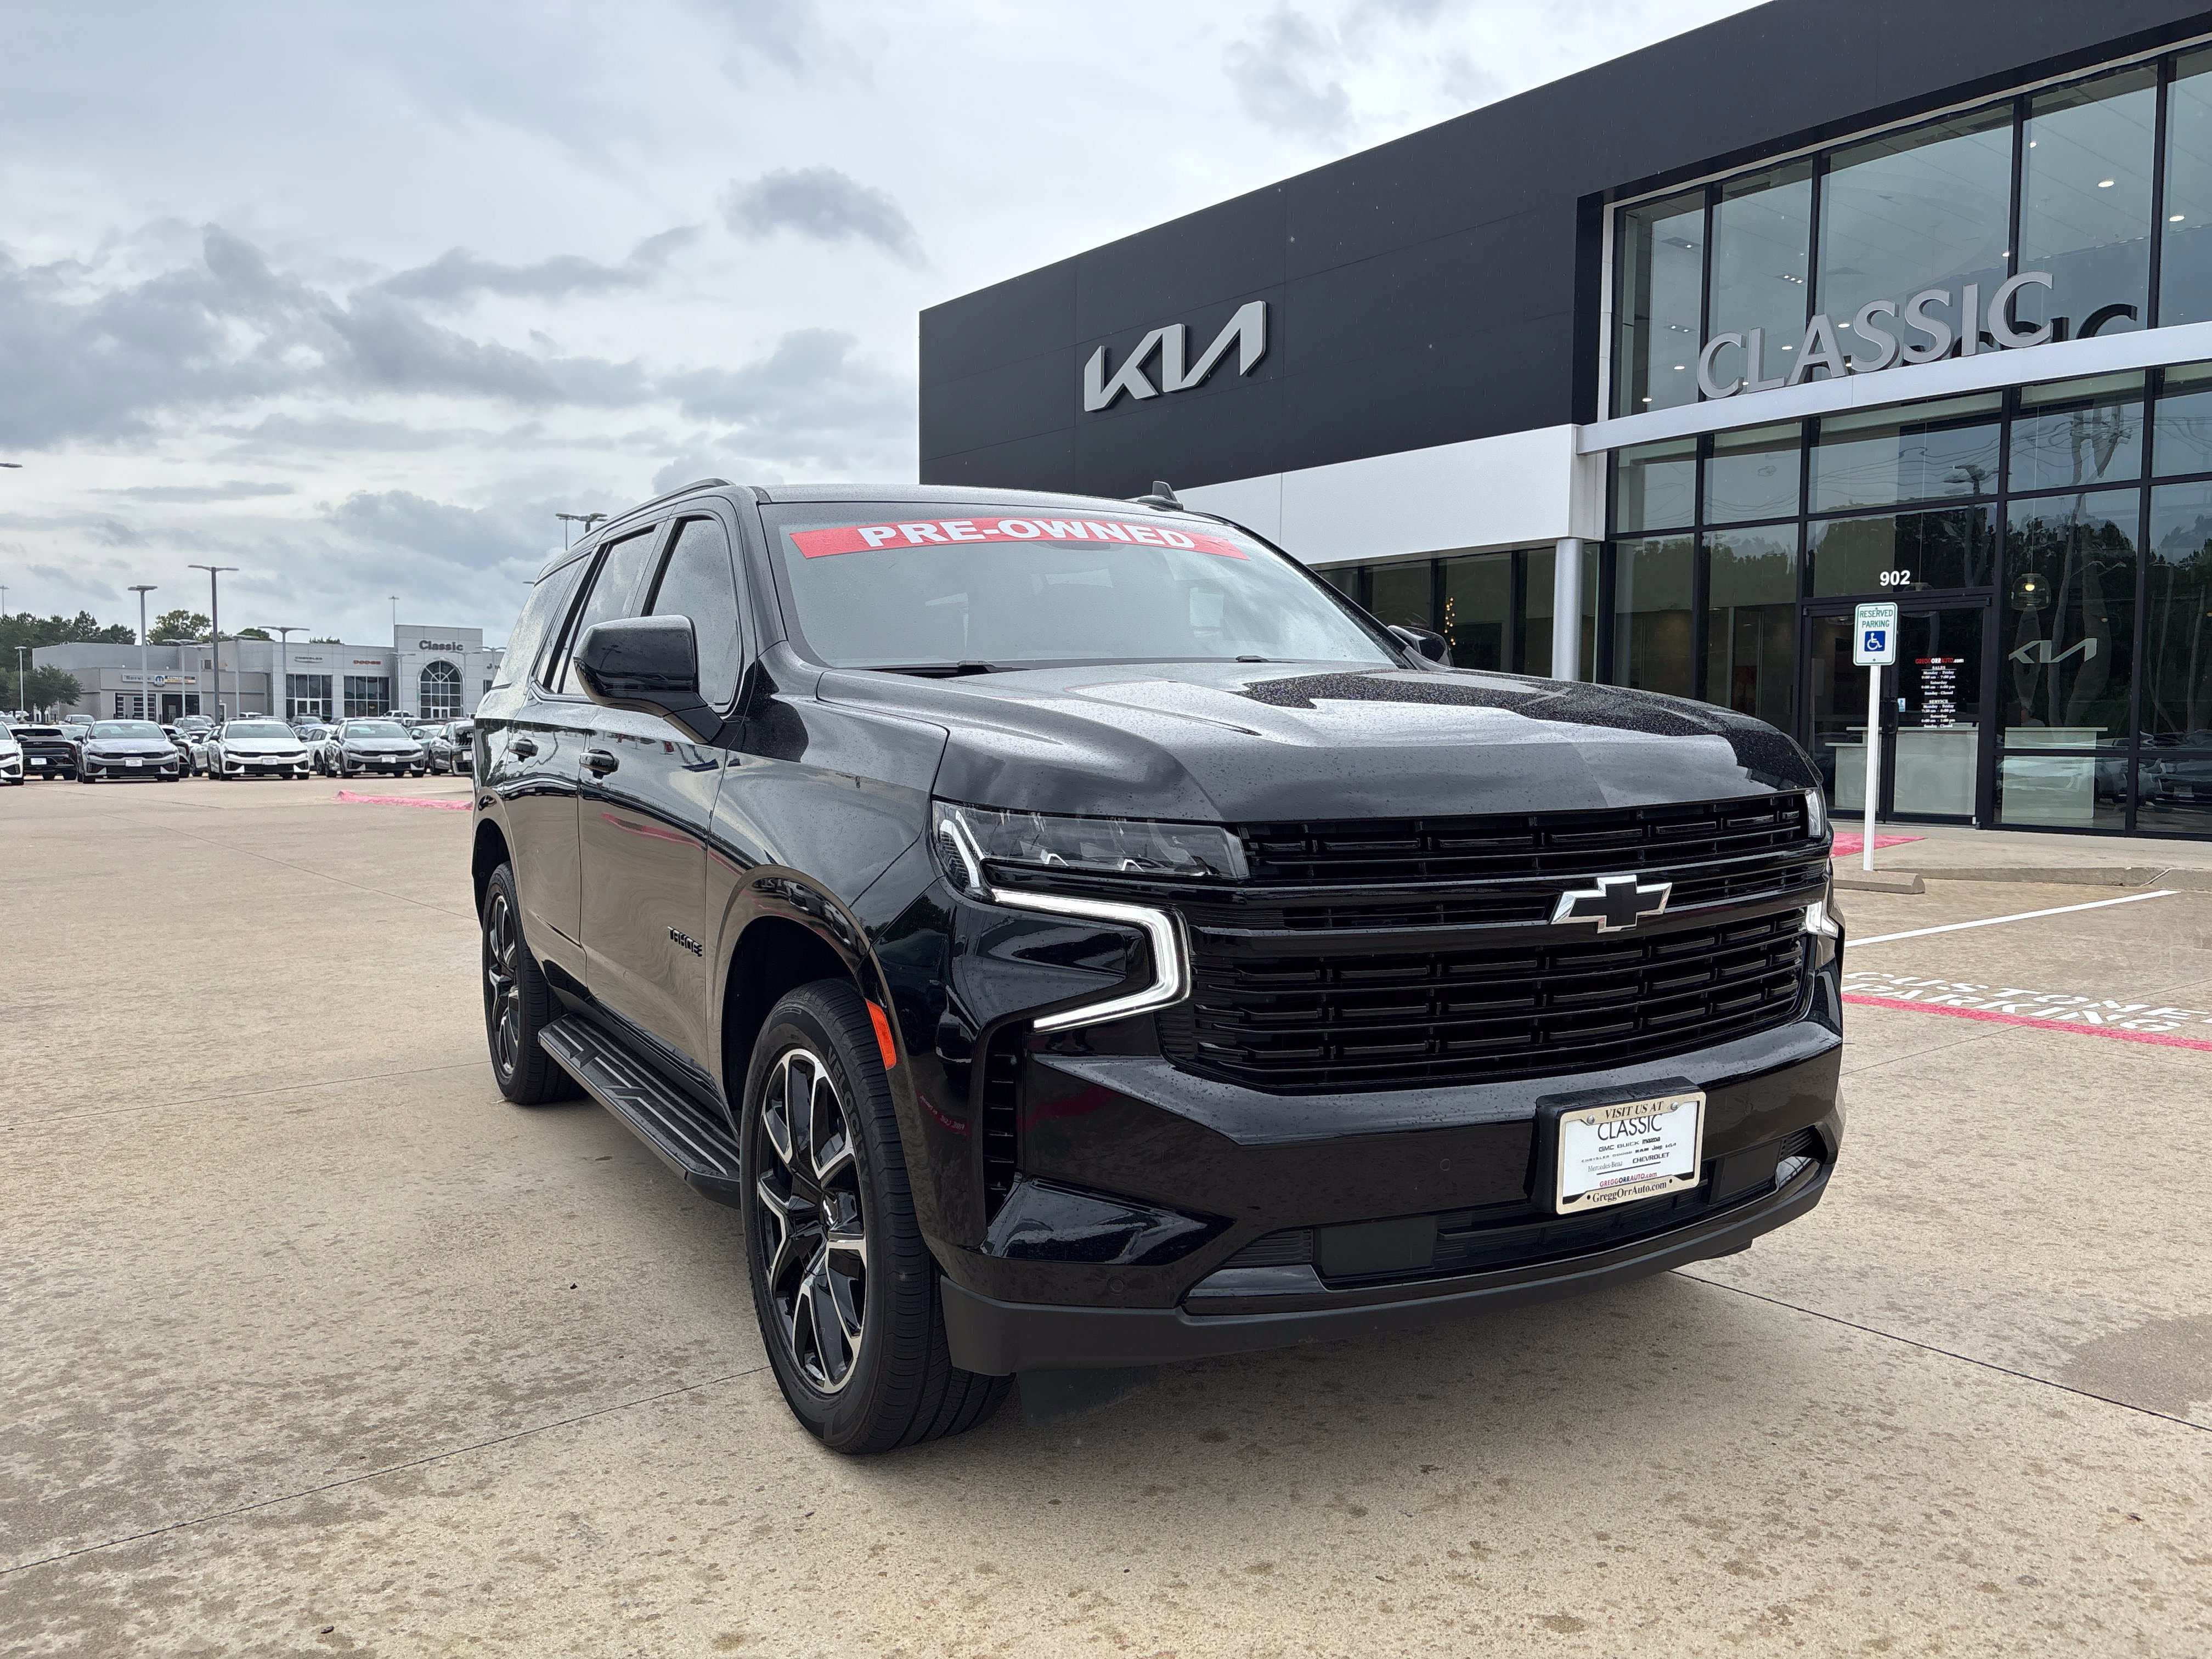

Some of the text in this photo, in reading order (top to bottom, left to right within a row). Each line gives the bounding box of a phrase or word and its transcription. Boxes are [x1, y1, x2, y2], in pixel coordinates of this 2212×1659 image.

[1697, 270, 2053, 398] CLASSIC
[1084, 301, 1266, 412] KIA
[857, 520, 1195, 549] PRE-OWNED
[1880, 570, 1910, 586] 902
[1859, 610, 1893, 618] RESERVED
[1861, 619, 1890, 628] PARKING
[419, 640, 464, 651] Classic
[1840, 983, 2181, 1031] PARKING
[1844, 972, 2212, 1023] CUSTOME
[1605, 1101, 1664, 1119] VISIT US AT
[1598, 1114, 1662, 1141] CLASSIC
[1588, 1152, 1670, 1172] Mercedes-Benz CHEVROLET
[1599, 1172, 1657, 1187] GREGGORRAUTO.com
[1593, 1182, 1667, 1202] GreggOrrAuto.com
